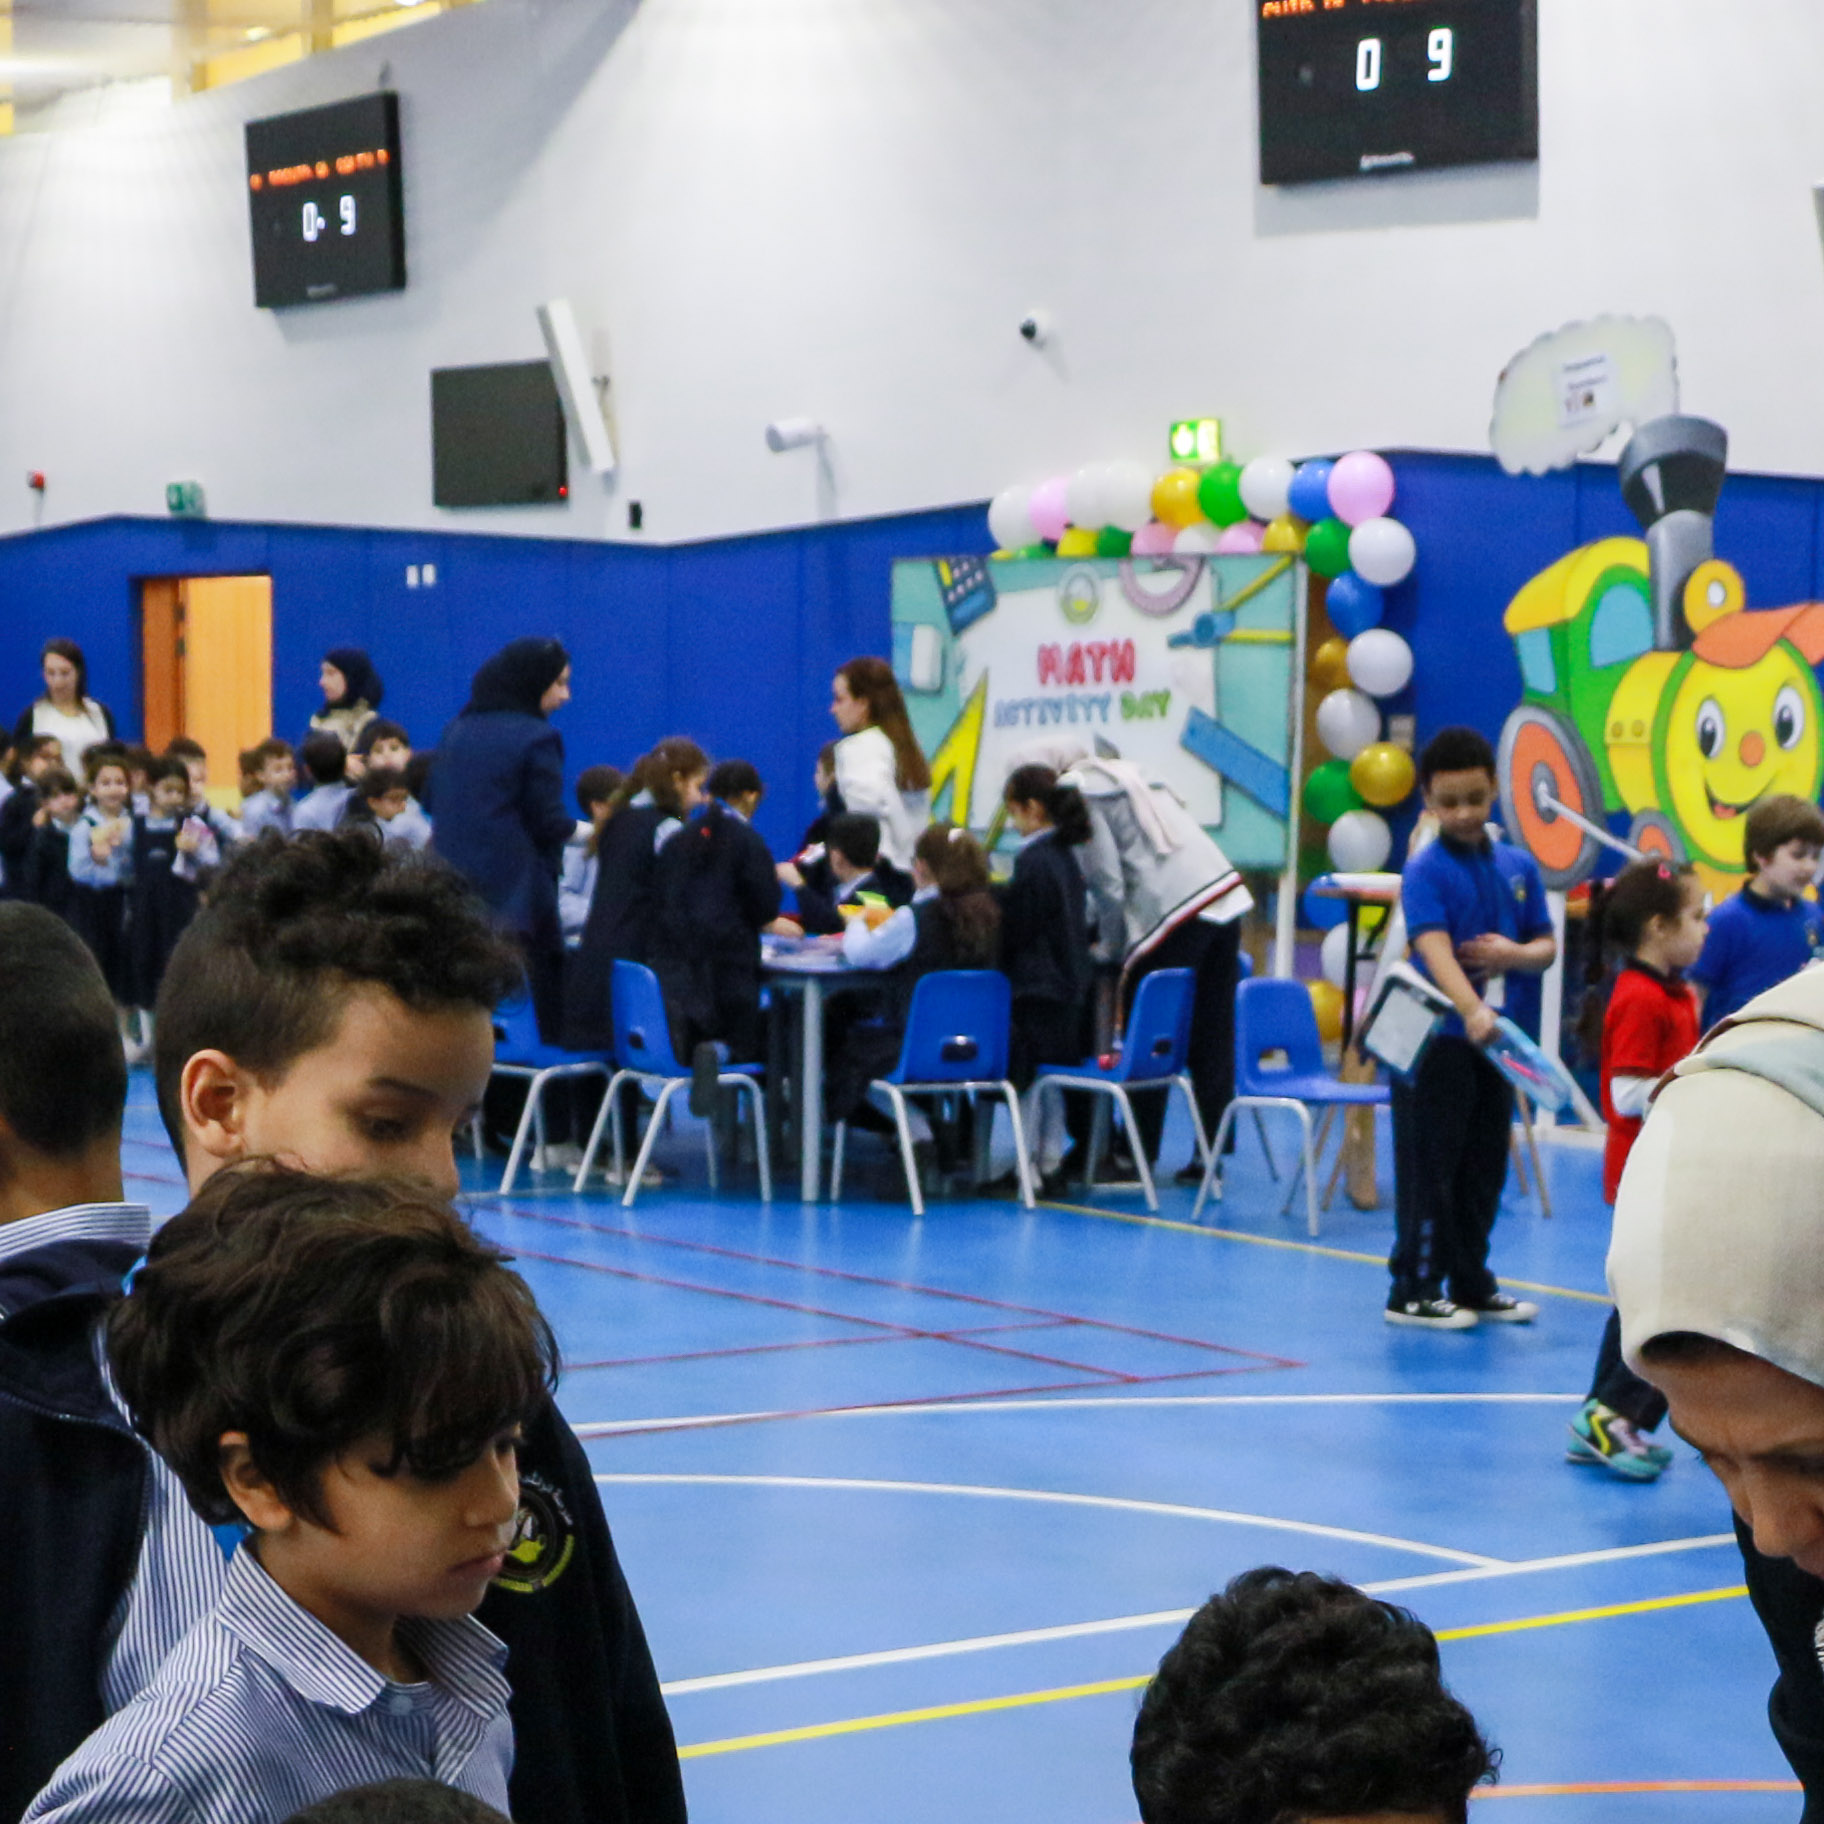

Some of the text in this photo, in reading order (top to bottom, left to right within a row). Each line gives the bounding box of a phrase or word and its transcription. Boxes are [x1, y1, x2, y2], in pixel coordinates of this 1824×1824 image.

[1356, 28, 1453, 91] 0 9
[340, 194, 356, 236] 9
[1037, 638, 1136, 685] MATH
[994, 688, 1171, 728] ACTIVITY DAY
